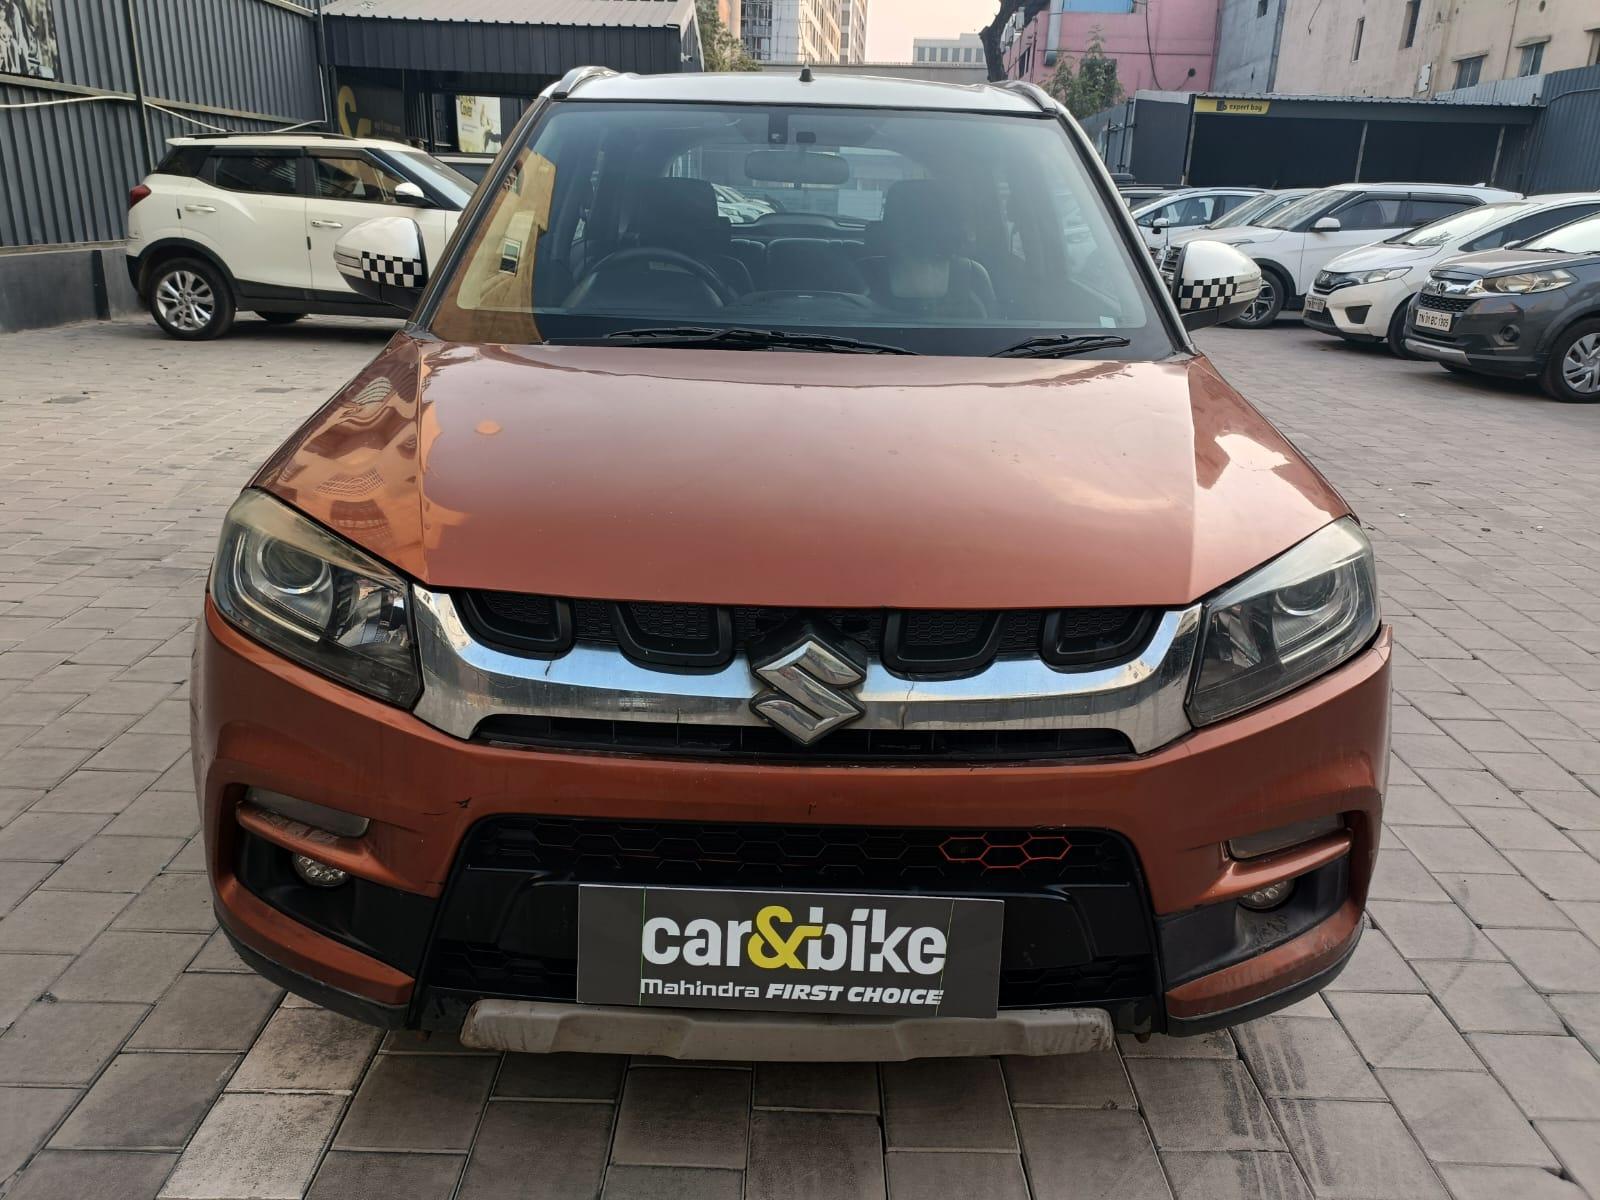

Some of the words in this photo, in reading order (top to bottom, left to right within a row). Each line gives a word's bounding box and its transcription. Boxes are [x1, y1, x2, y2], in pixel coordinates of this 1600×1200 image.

[1229, 104, 1249, 112] expert
[1419, 313, 1425, 322] TN
[642, 905, 947, 975] car&bike
[640, 978, 760, 998] Mahindra
[765, 983, 845, 1001] FIRST
[848, 986, 944, 1005] CHOICE
